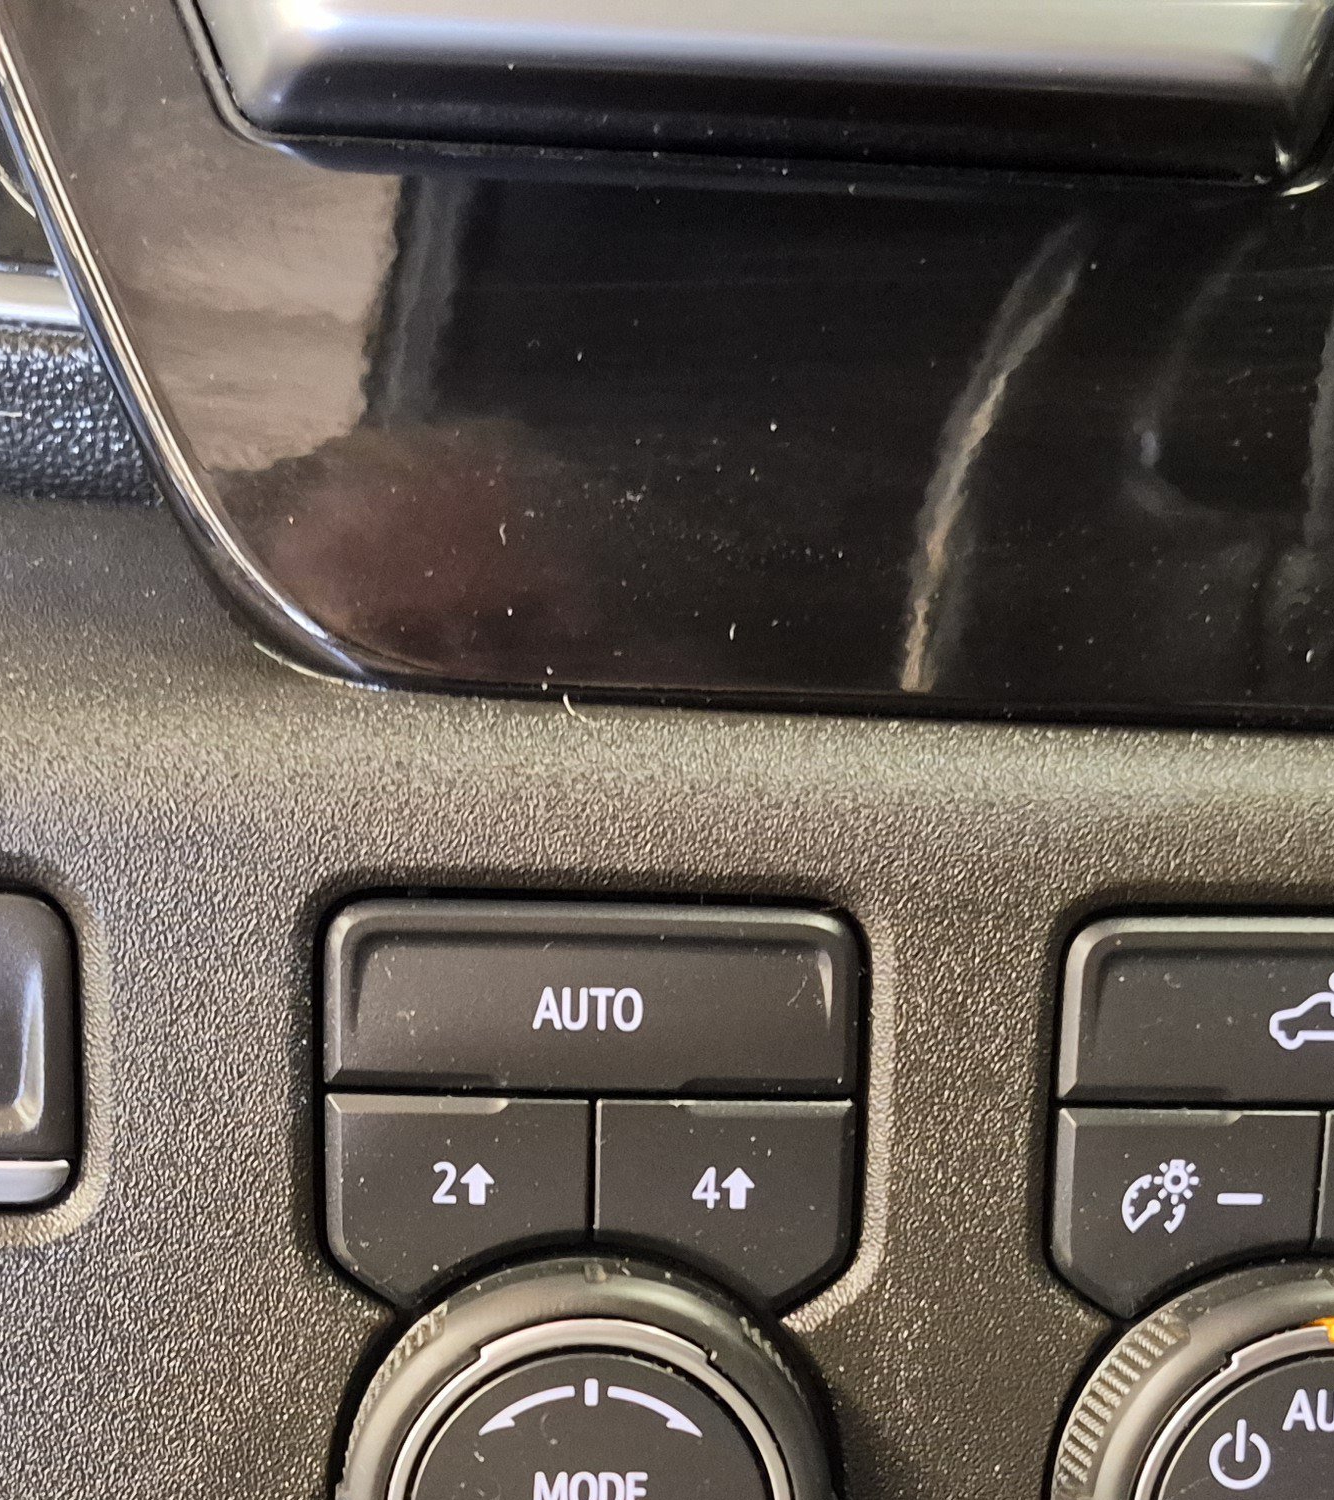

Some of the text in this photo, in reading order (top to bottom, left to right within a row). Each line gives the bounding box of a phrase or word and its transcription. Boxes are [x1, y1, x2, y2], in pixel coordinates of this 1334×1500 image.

[531, 985, 644, 1032] AUTO
[431, 1161, 457, 1205] 2
[691, 1166, 721, 1210] 4
